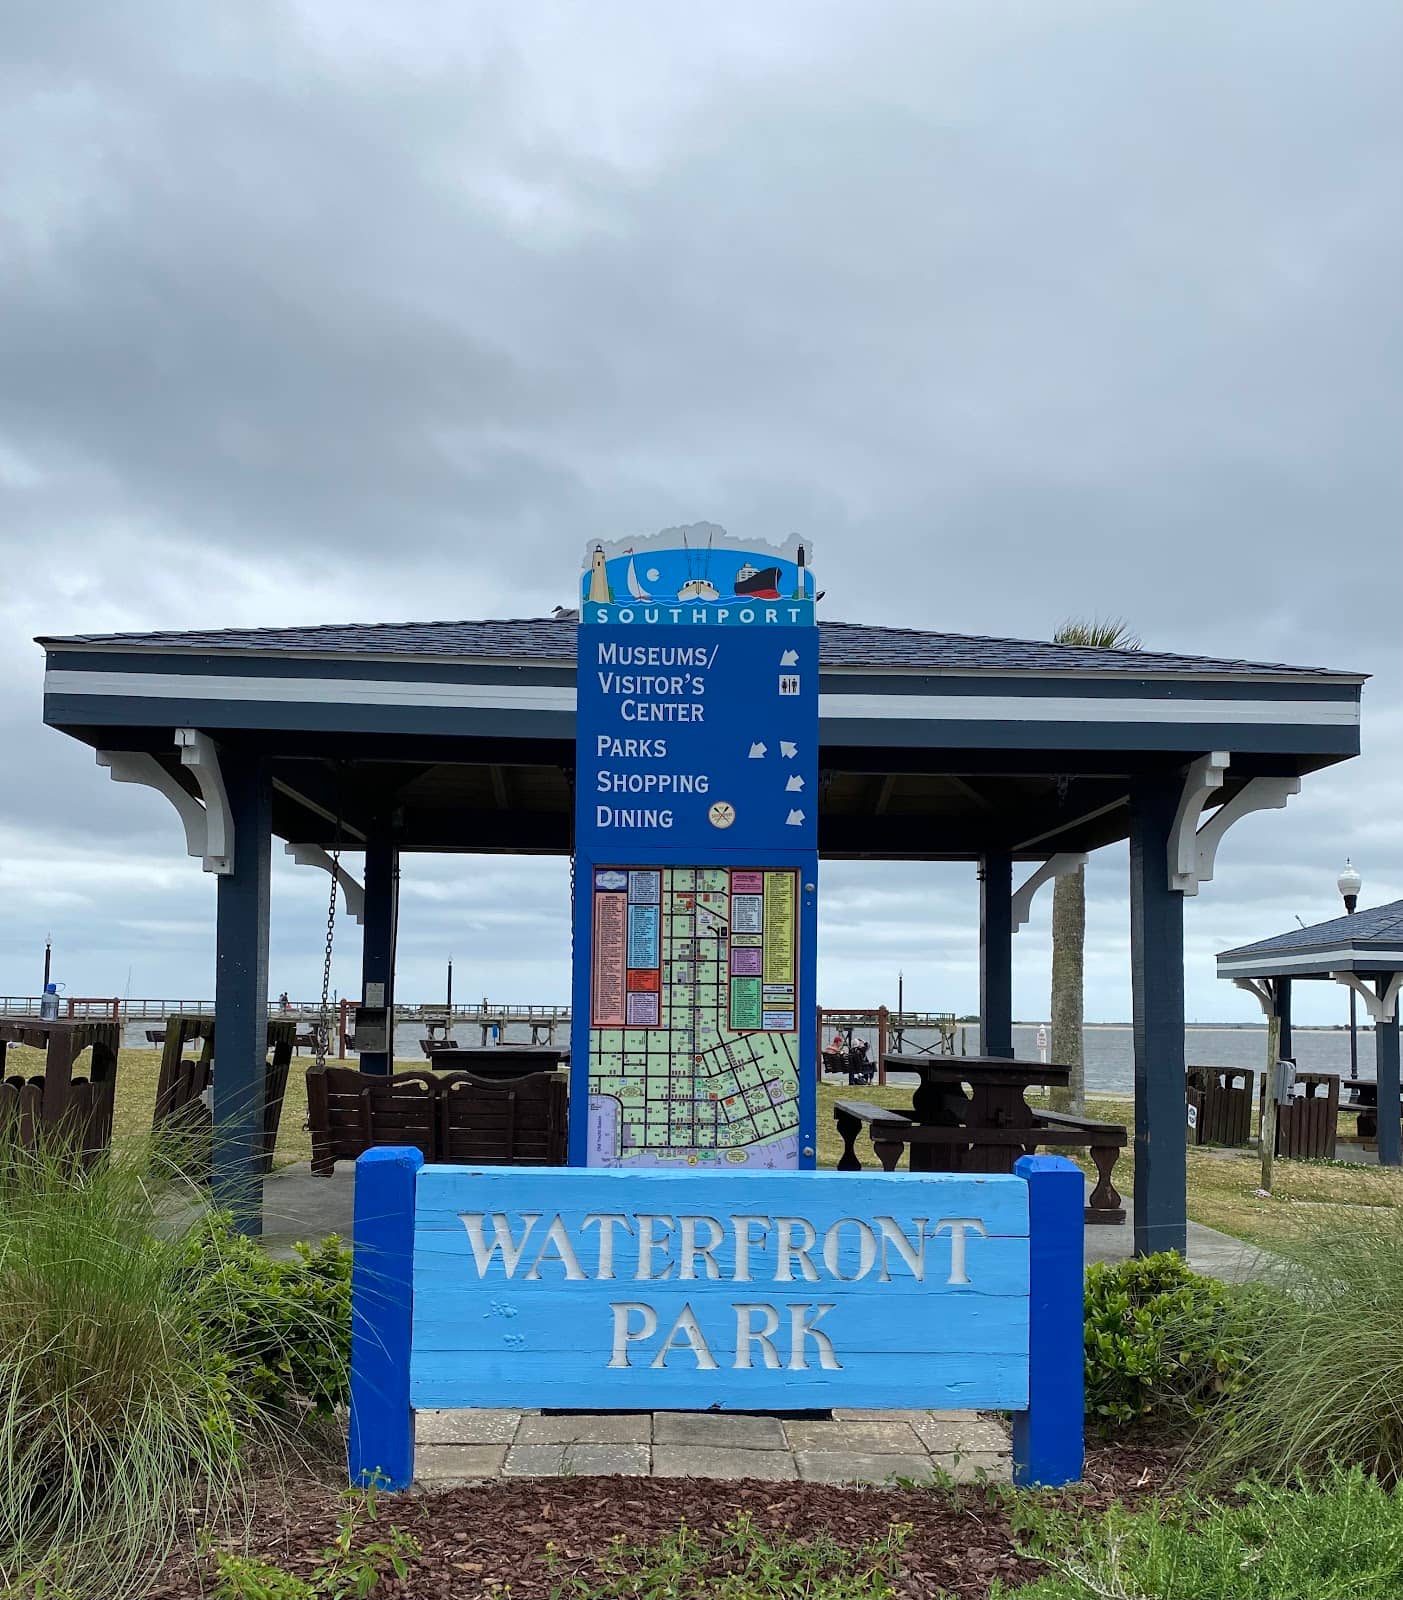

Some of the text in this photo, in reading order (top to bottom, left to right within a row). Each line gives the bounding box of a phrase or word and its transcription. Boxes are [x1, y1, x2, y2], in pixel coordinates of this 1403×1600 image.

[597, 608, 801, 624] SOUTHPORT
[598, 643, 719, 669] MUSEUMS/
[598, 672, 705, 694] VISITOR'S
[621, 699, 704, 722] CENTER
[597, 735, 667, 758] PARKS
[597, 770, 709, 793] SHOPPING
[597, 805, 673, 828] DINING
[458, 1213, 989, 1285] WATERFRONT
[607, 1302, 843, 1370] PARK
